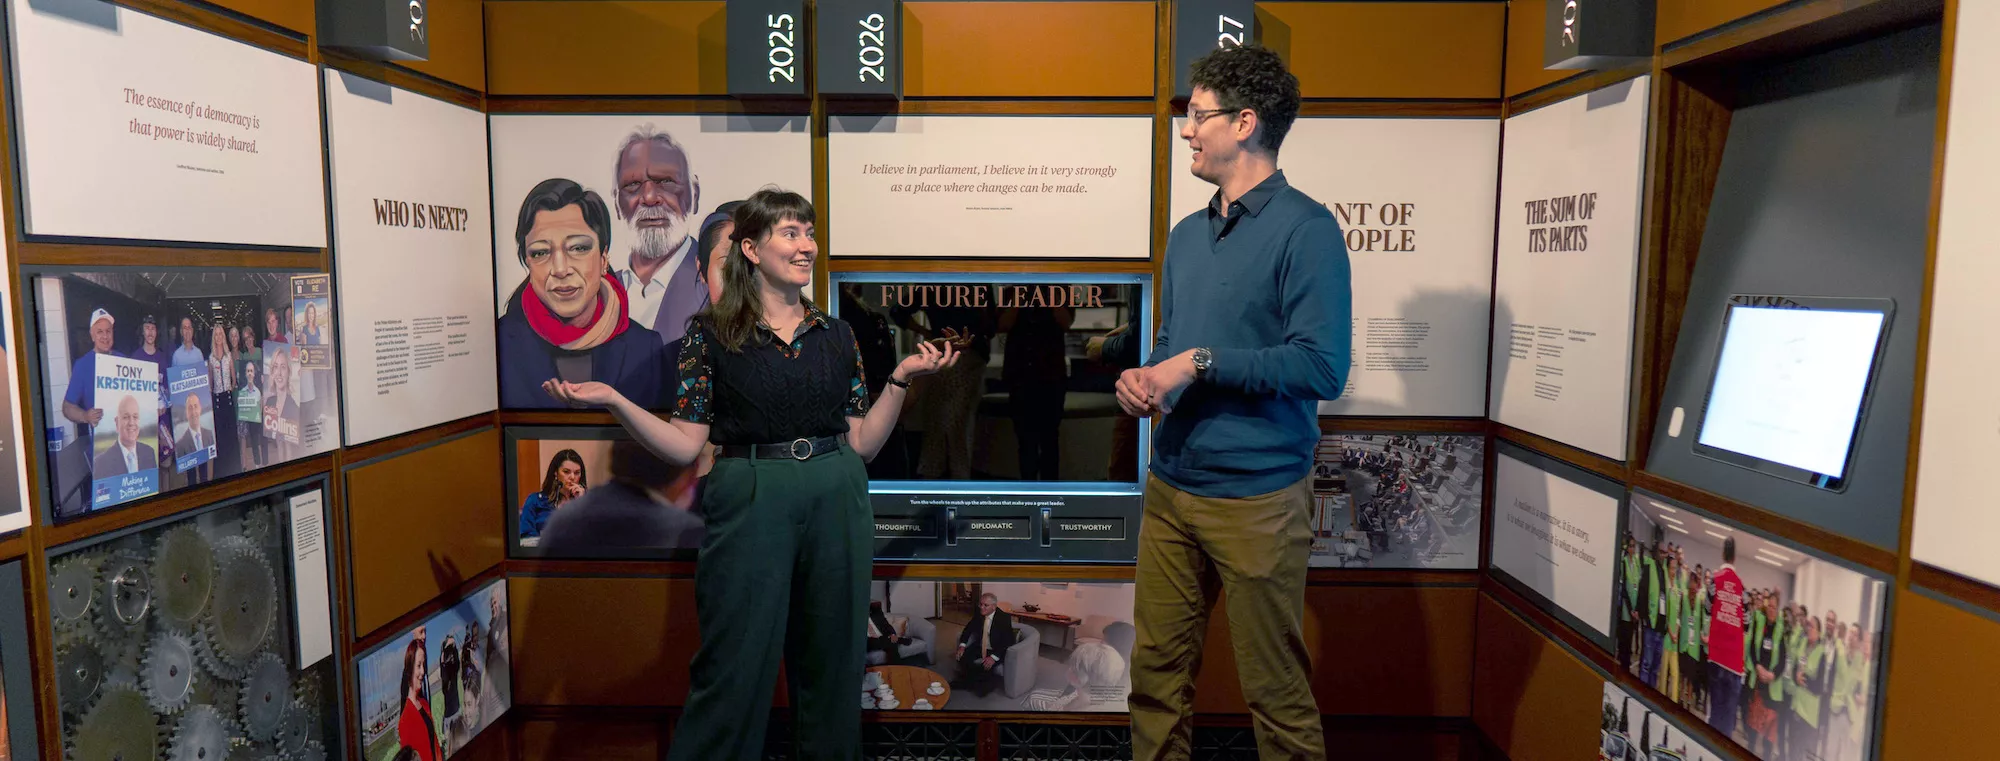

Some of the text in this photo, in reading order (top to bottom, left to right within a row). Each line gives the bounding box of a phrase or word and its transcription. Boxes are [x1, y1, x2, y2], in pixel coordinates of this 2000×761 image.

[409, 0, 424, 45] 20
[1218, 14, 1244, 50] 27
[1562, 0, 1577, 47] 20
[768, 14, 794, 83] 2025
[859, 13, 884, 83] 2026
[123, 88, 260, 130] The essence of a democracy is
[129, 118, 259, 154] that power is widely shared.
[862, 164, 1117, 178] I believe in parliament, I believe in it very strongly
[890, 182, 1088, 195] as a place where changes can be made.
[373, 198, 468, 232] WHO IS NEXT?
[1324, 202, 1415, 226] NT OF
[1524, 192, 1597, 225] THE SUM OF
[1341, 228, 1415, 252] OPLE
[1528, 225, 1588, 253] ITS PARTS
[880, 284, 1104, 308] FUTURE LEADER
[116, 364, 143, 379] TONY
[181, 368, 198, 379] PETER
[96, 376, 158, 392] KRSTICEVIC
[264, 414, 298, 437] Collins
[119, 486, 151, 500] Difference
[122, 476, 144, 487] Making
[875, 523, 922, 532] THOUGHTFUL
[971, 522, 1013, 530] DIPLOMATIC
